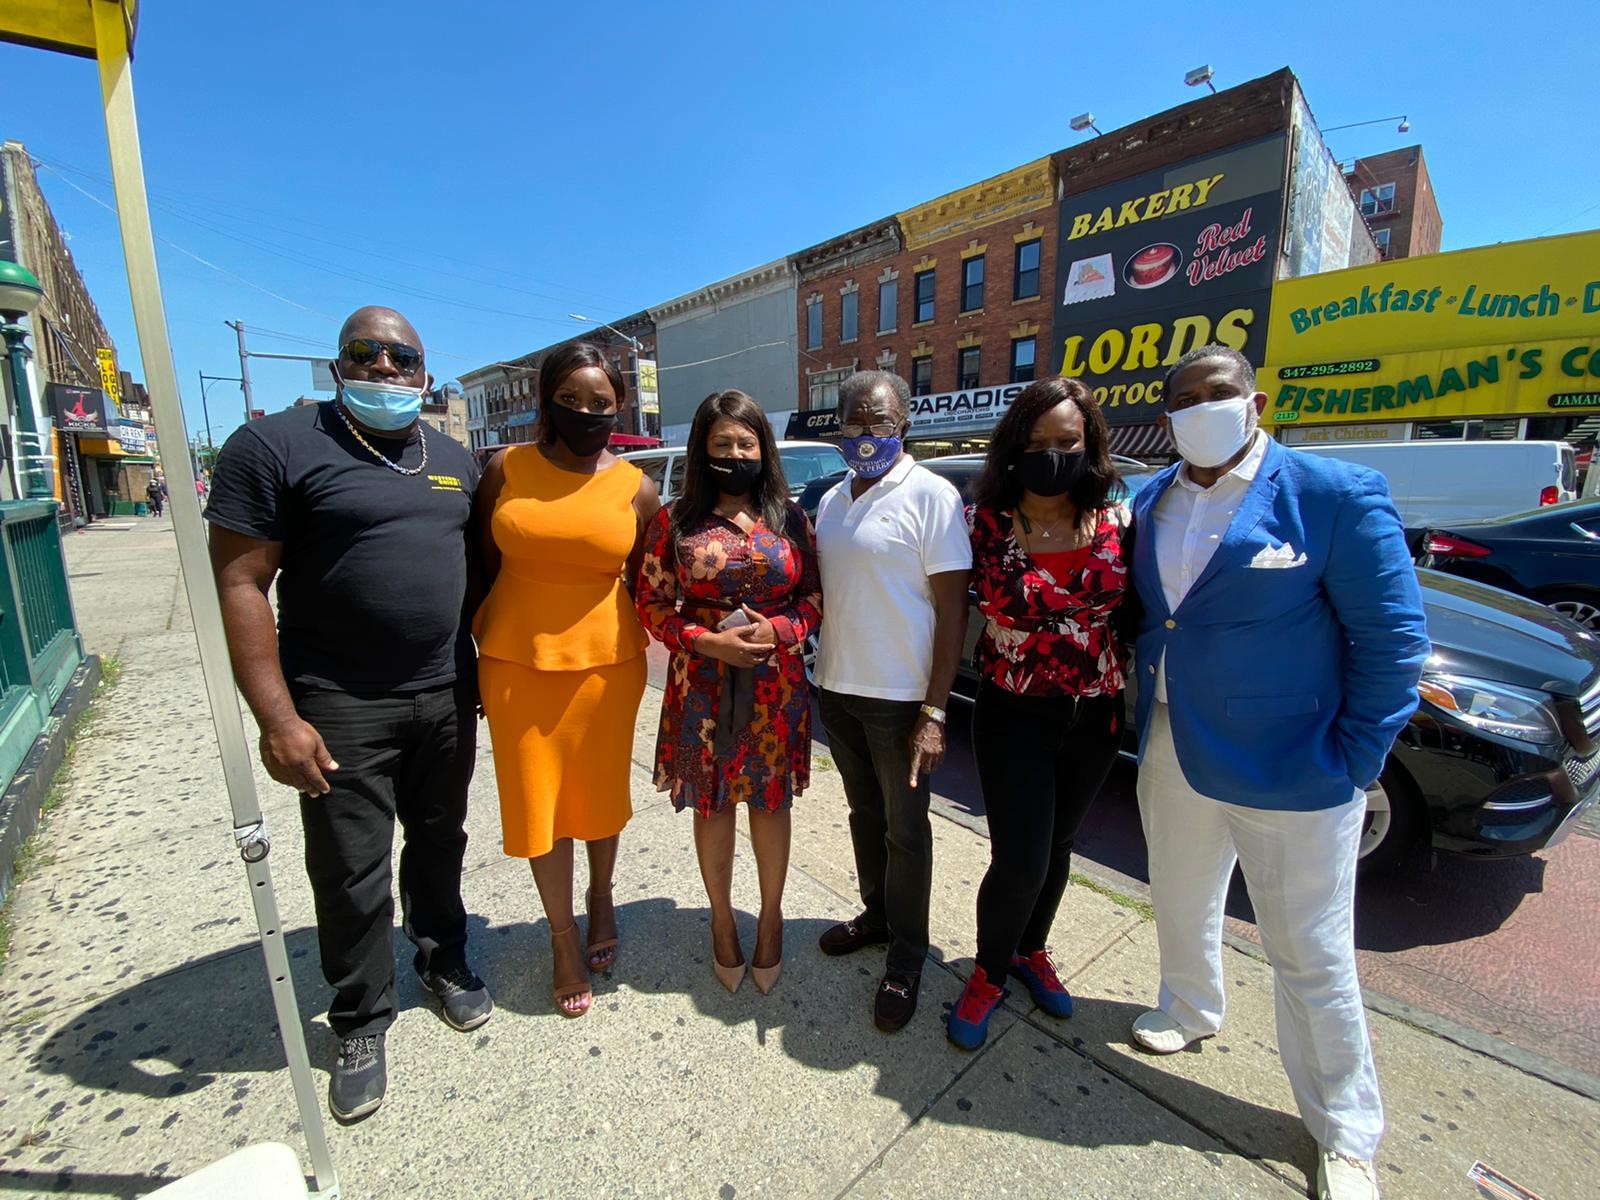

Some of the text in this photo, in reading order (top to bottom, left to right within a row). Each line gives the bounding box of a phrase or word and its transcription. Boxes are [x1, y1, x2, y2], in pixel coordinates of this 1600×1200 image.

[1067, 174, 1224, 241] BAKERY
[1194, 207, 1252, 257] Red
[1186, 235, 1266, 286] Velvet
[1289, 282, 1442, 334] Breakfast
[1458, 284, 1560, 318] Lunch
[1059, 308, 1254, 377] LORDS
[1092, 380, 1164, 407] OTOC
[1275, 348, 1543, 414] FISHERMAN'S
[1283, 361, 1373, 378] 347-295-2892
[807, 414, 833, 427] GET
[910, 385, 1030, 415] PARADIS
[1302, 426, 1388, 440] Jerk Chicken
